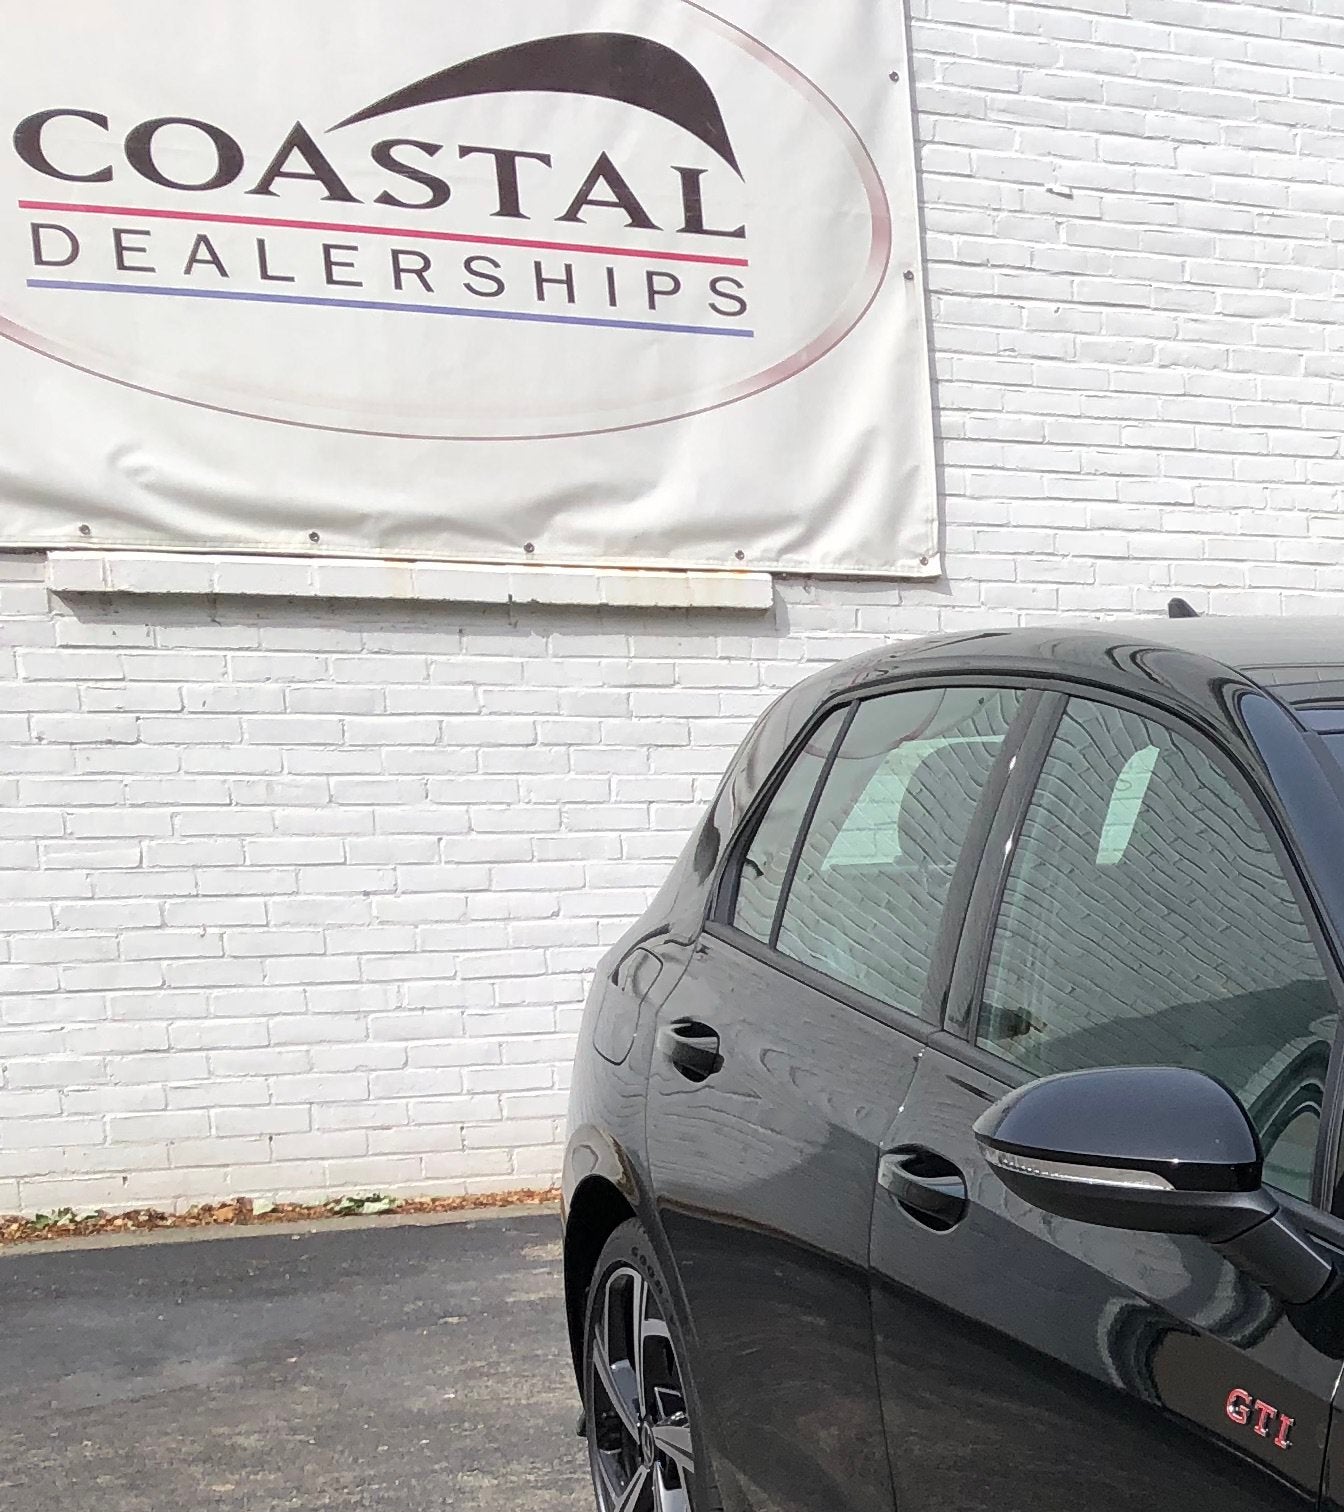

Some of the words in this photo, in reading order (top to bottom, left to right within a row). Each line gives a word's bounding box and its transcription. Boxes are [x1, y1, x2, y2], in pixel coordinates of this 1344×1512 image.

[13, 108, 747, 240] COASTAL
[30, 222, 749, 317] DEALERSHIPS
[1226, 1388, 1295, 1450] GTI
